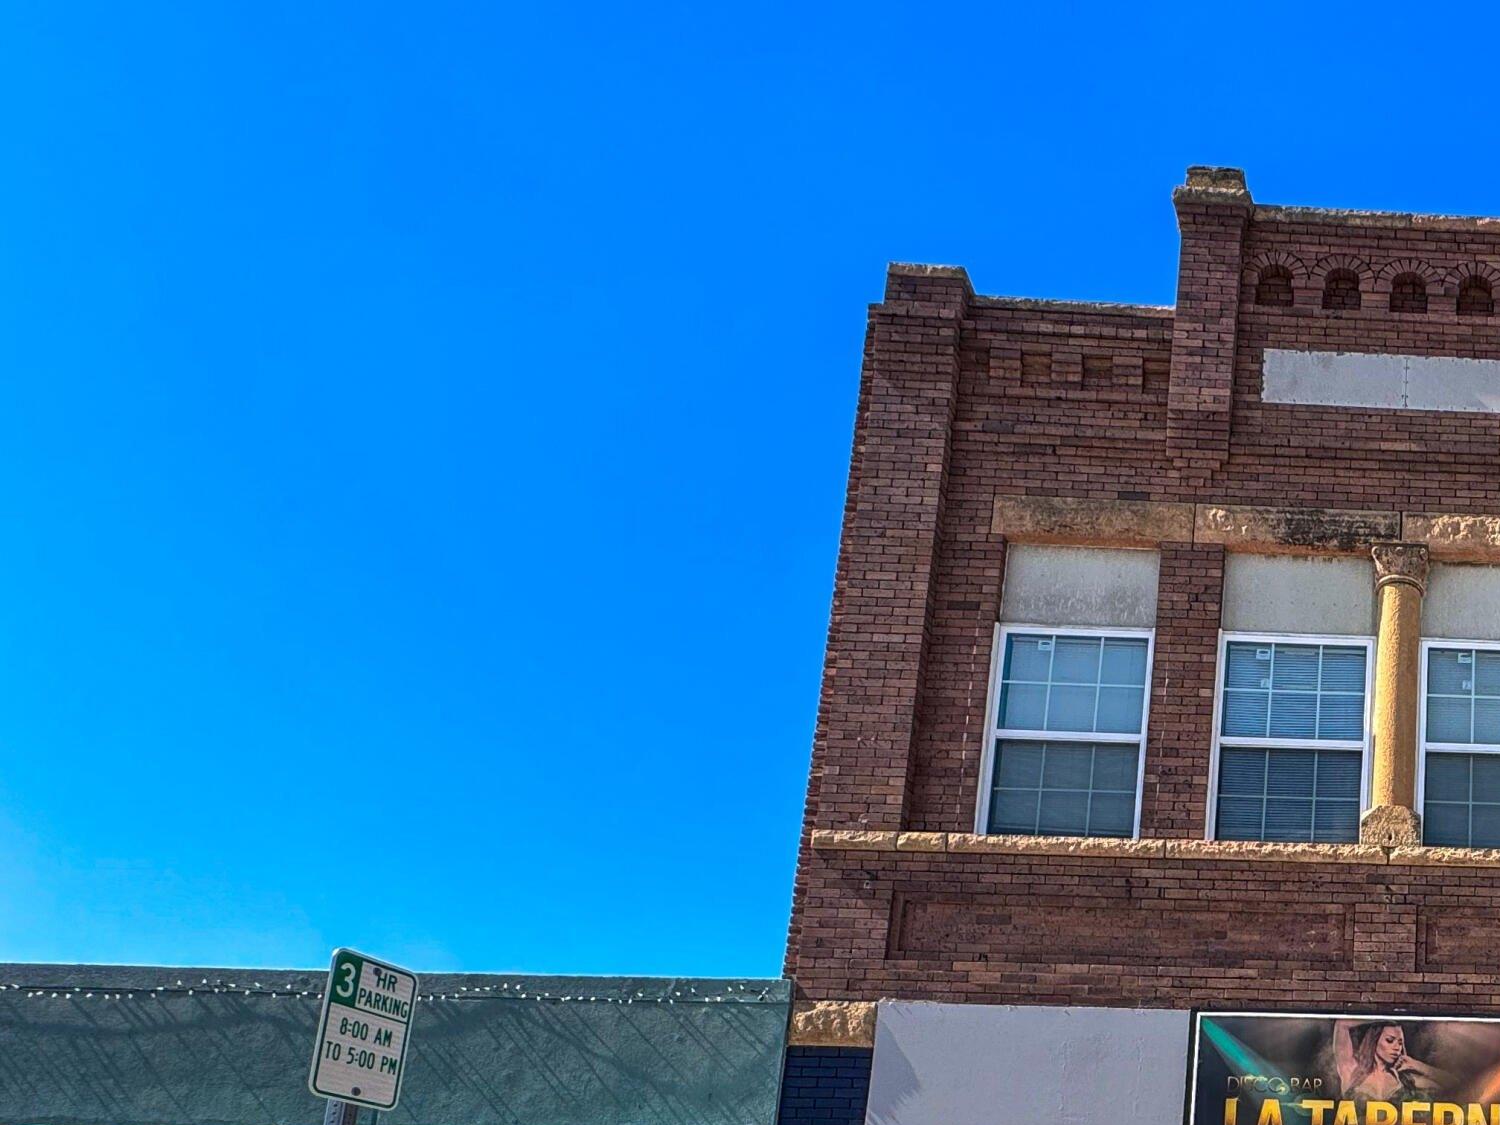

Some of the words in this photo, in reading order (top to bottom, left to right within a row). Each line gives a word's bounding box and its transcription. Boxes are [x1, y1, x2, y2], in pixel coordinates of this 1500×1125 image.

[336, 962, 356, 998] 3
[376, 972, 398, 993] HR
[358, 987, 409, 1019] PARKING
[340, 1017, 369, 1041] 8:00
[374, 1028, 393, 1048] AM
[325, 1040, 342, 1061] TO
[346, 1047, 376, 1070] 5:00
[380, 1055, 398, 1076] PM
[1227, 1075, 1289, 1095] DISCO
[1291, 1078, 1323, 1094] BAR
